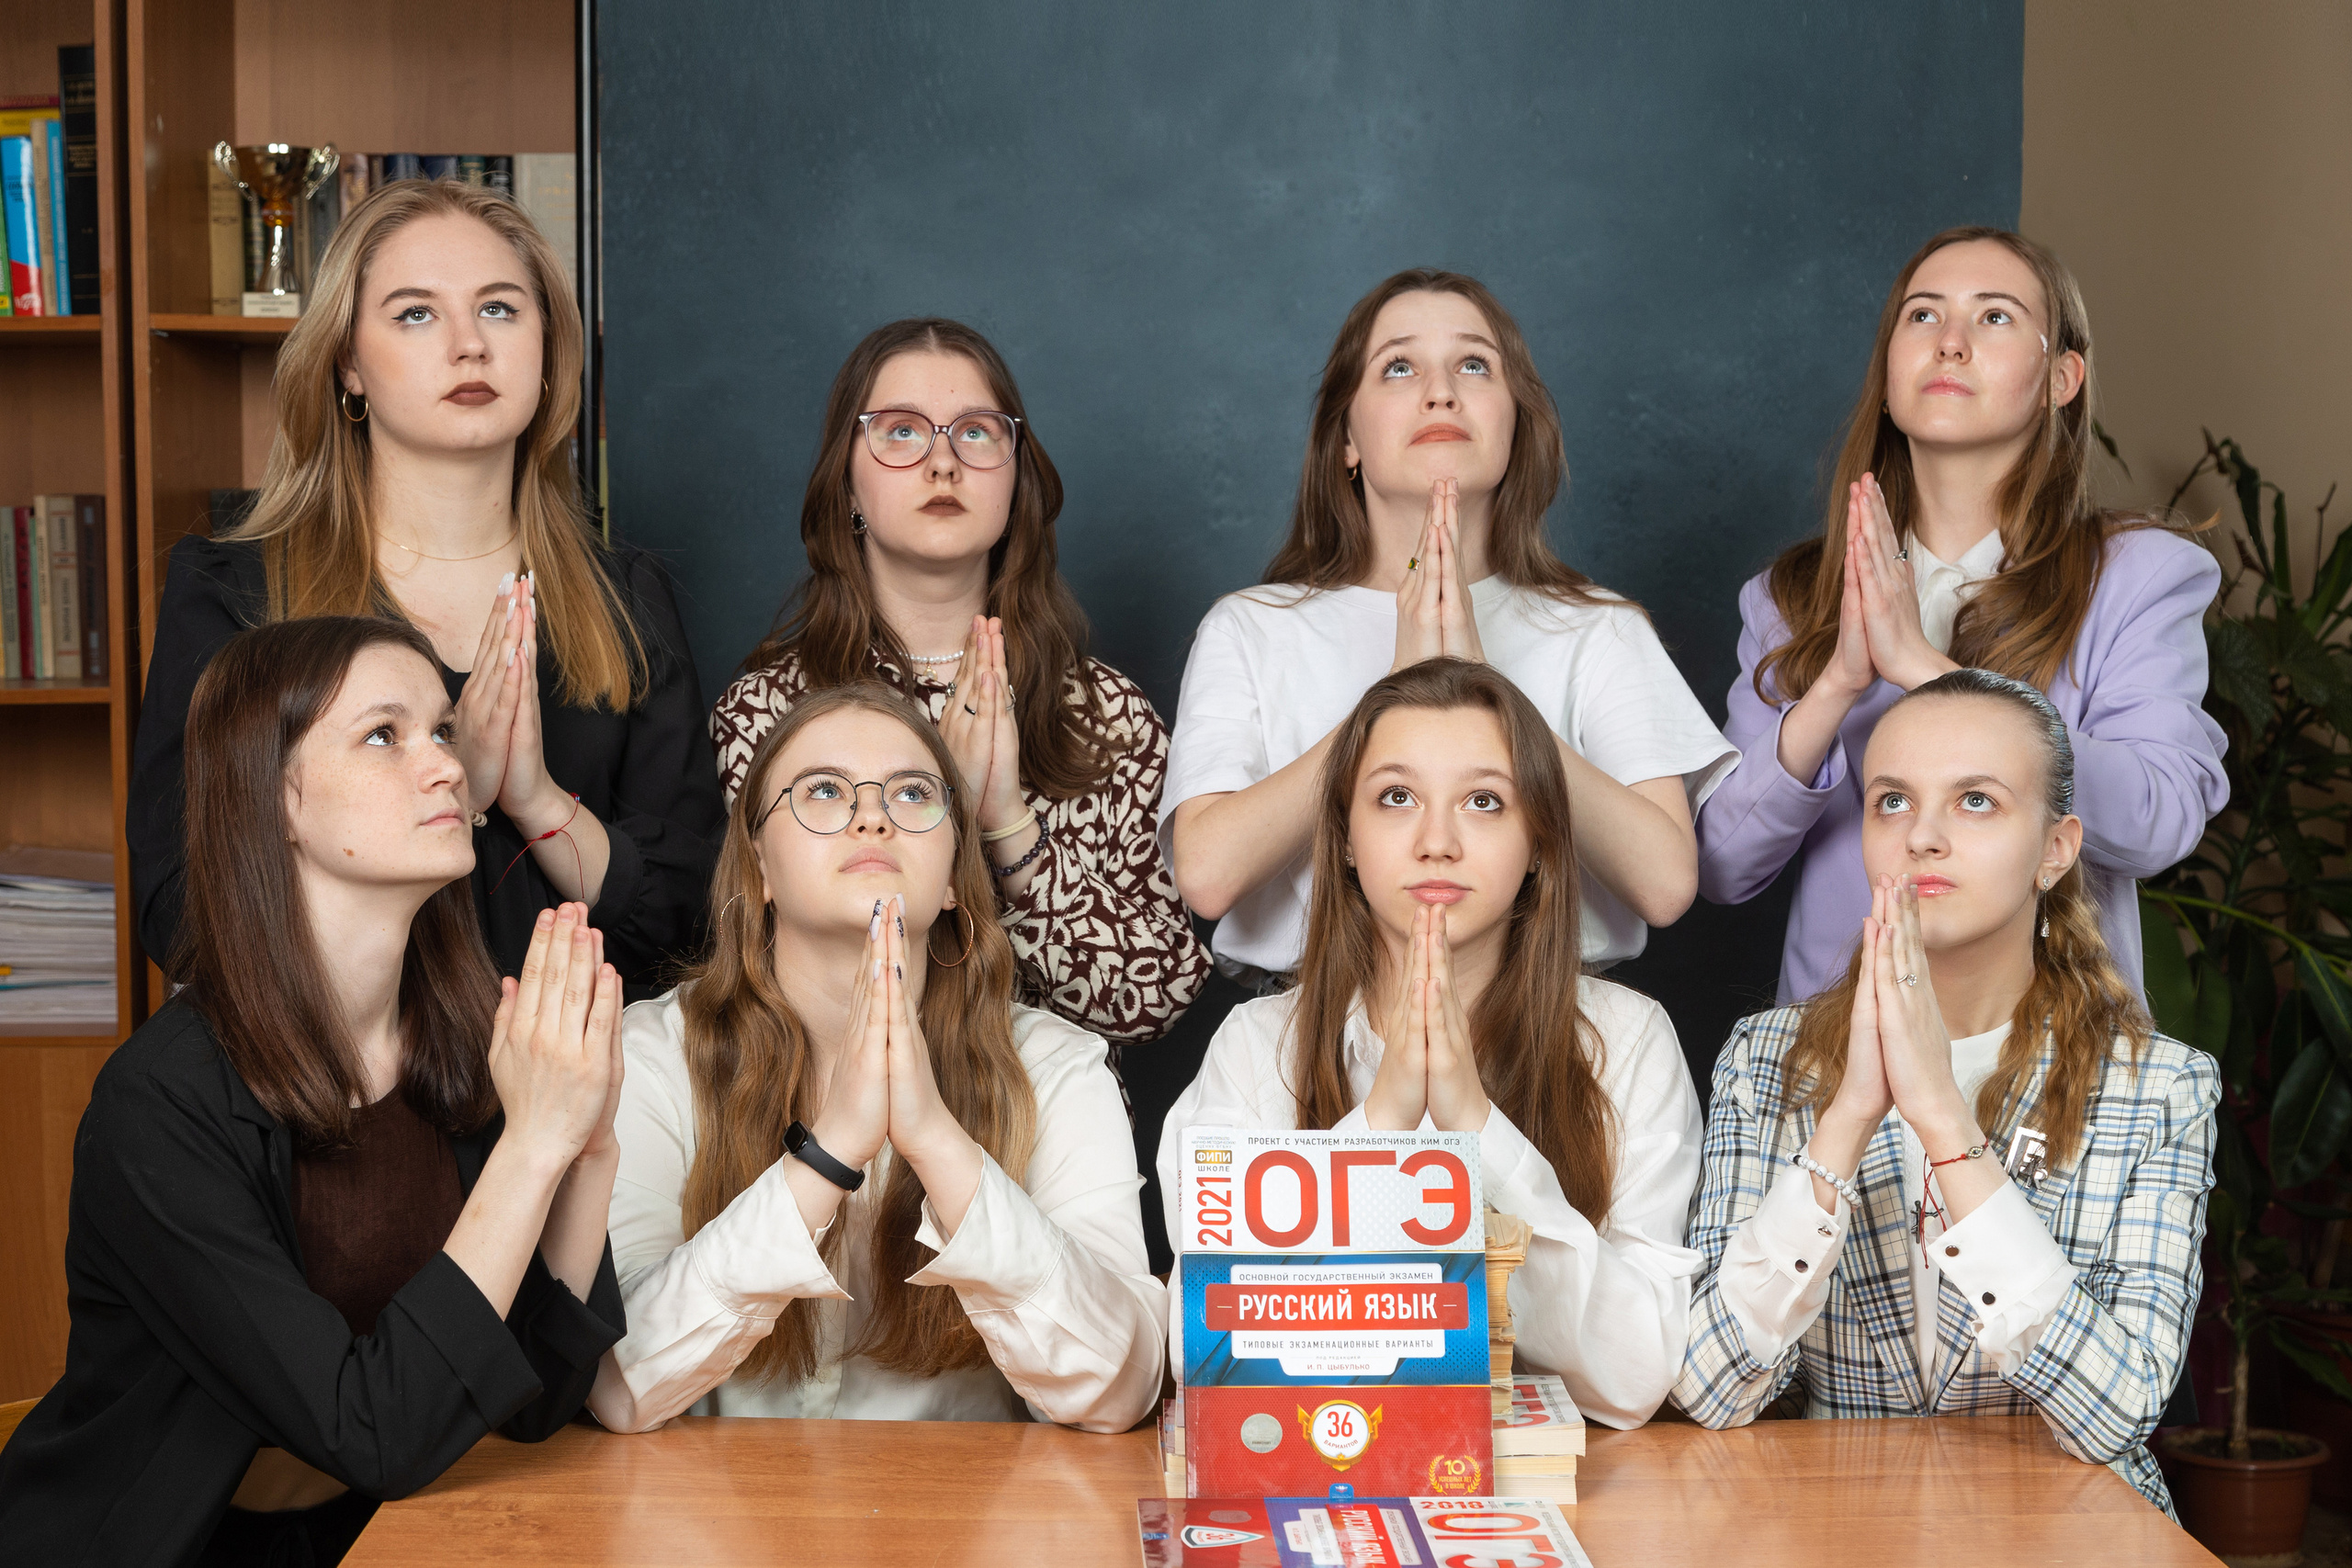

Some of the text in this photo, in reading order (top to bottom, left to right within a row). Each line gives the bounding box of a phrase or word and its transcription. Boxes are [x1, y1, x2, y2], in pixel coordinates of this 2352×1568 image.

[1248, 1136, 1281, 1145] ПРОЕКТ
[1284, 1137, 1290, 1145] С
[1295, 1137, 1340, 1145] УЧАСТИЕМ
[1344, 1137, 1417, 1145] РАЗРАБОТЧИКОВ
[1196, 1151, 1231, 1162] ФИПИ
[1244, 1149, 1472, 1248] ОГЭ
[1195, 1177, 1233, 1247] 2021
[1238, 1271, 1433, 1282] ОСНОВНОЙ ГОСУДАРСТВЕННЫЙ ЭКЗАМЕН
[1238, 1288, 1438, 1321] РУССКИЙ ЯЗЫК
[1242, 1339, 1433, 1349] ТИПОВЫЕ ЭКЗАМЕНАЦИОННЫЕ ВАРИАНТЫ
[1328, 1363, 1370, 1371] ЦЫБУЛЬКО
[1327, 1411, 1353, 1438] 36
[1323, 1438, 1359, 1450] ВАРИАНТОВ
[1443, 1459, 1465, 1475] 10
[1419, 1501, 1485, 1509] 2018
